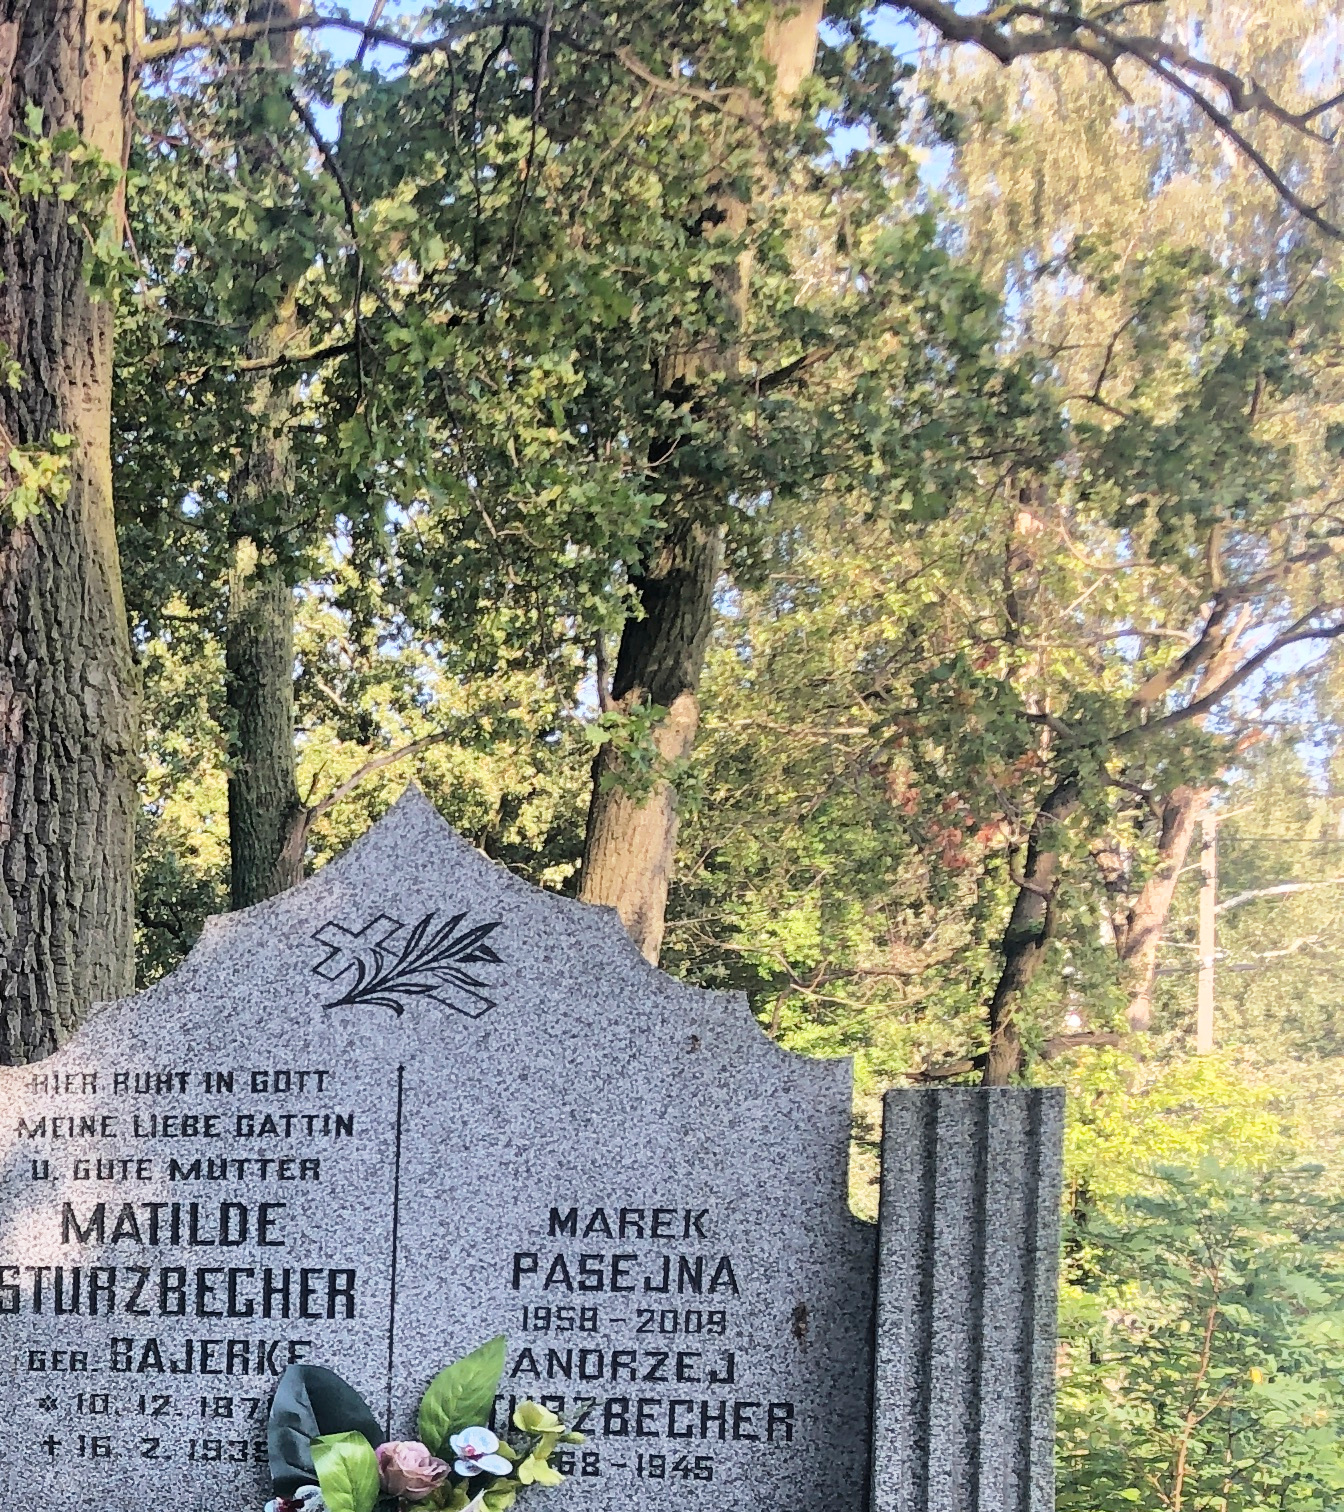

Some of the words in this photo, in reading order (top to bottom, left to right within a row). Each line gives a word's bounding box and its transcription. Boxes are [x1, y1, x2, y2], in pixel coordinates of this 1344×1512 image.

[32, 1071, 97, 1094] HIER
[113, 1071, 190, 1095] RUHT
[205, 1071, 234, 1094] IN
[250, 1070, 330, 1093] GOTT
[14, 1115, 118, 1139] MEINE
[133, 1114, 221, 1138] LIEBE
[235, 1113, 354, 1138] GATTIN
[31, 1158, 59, 1181] U.
[73, 1158, 152, 1181] GUTE
[169, 1157, 320, 1182] MUTTER
[60, 1201, 287, 1247] MATILDE
[547, 1207, 709, 1240] MAREK
[511, 1252, 739, 1295] PASEJNA
[27, 1350, 99, 1372] GEB.
[510, 1347, 736, 1384] ANDRZEJ
[200, 1395, 275, 1419] 187
